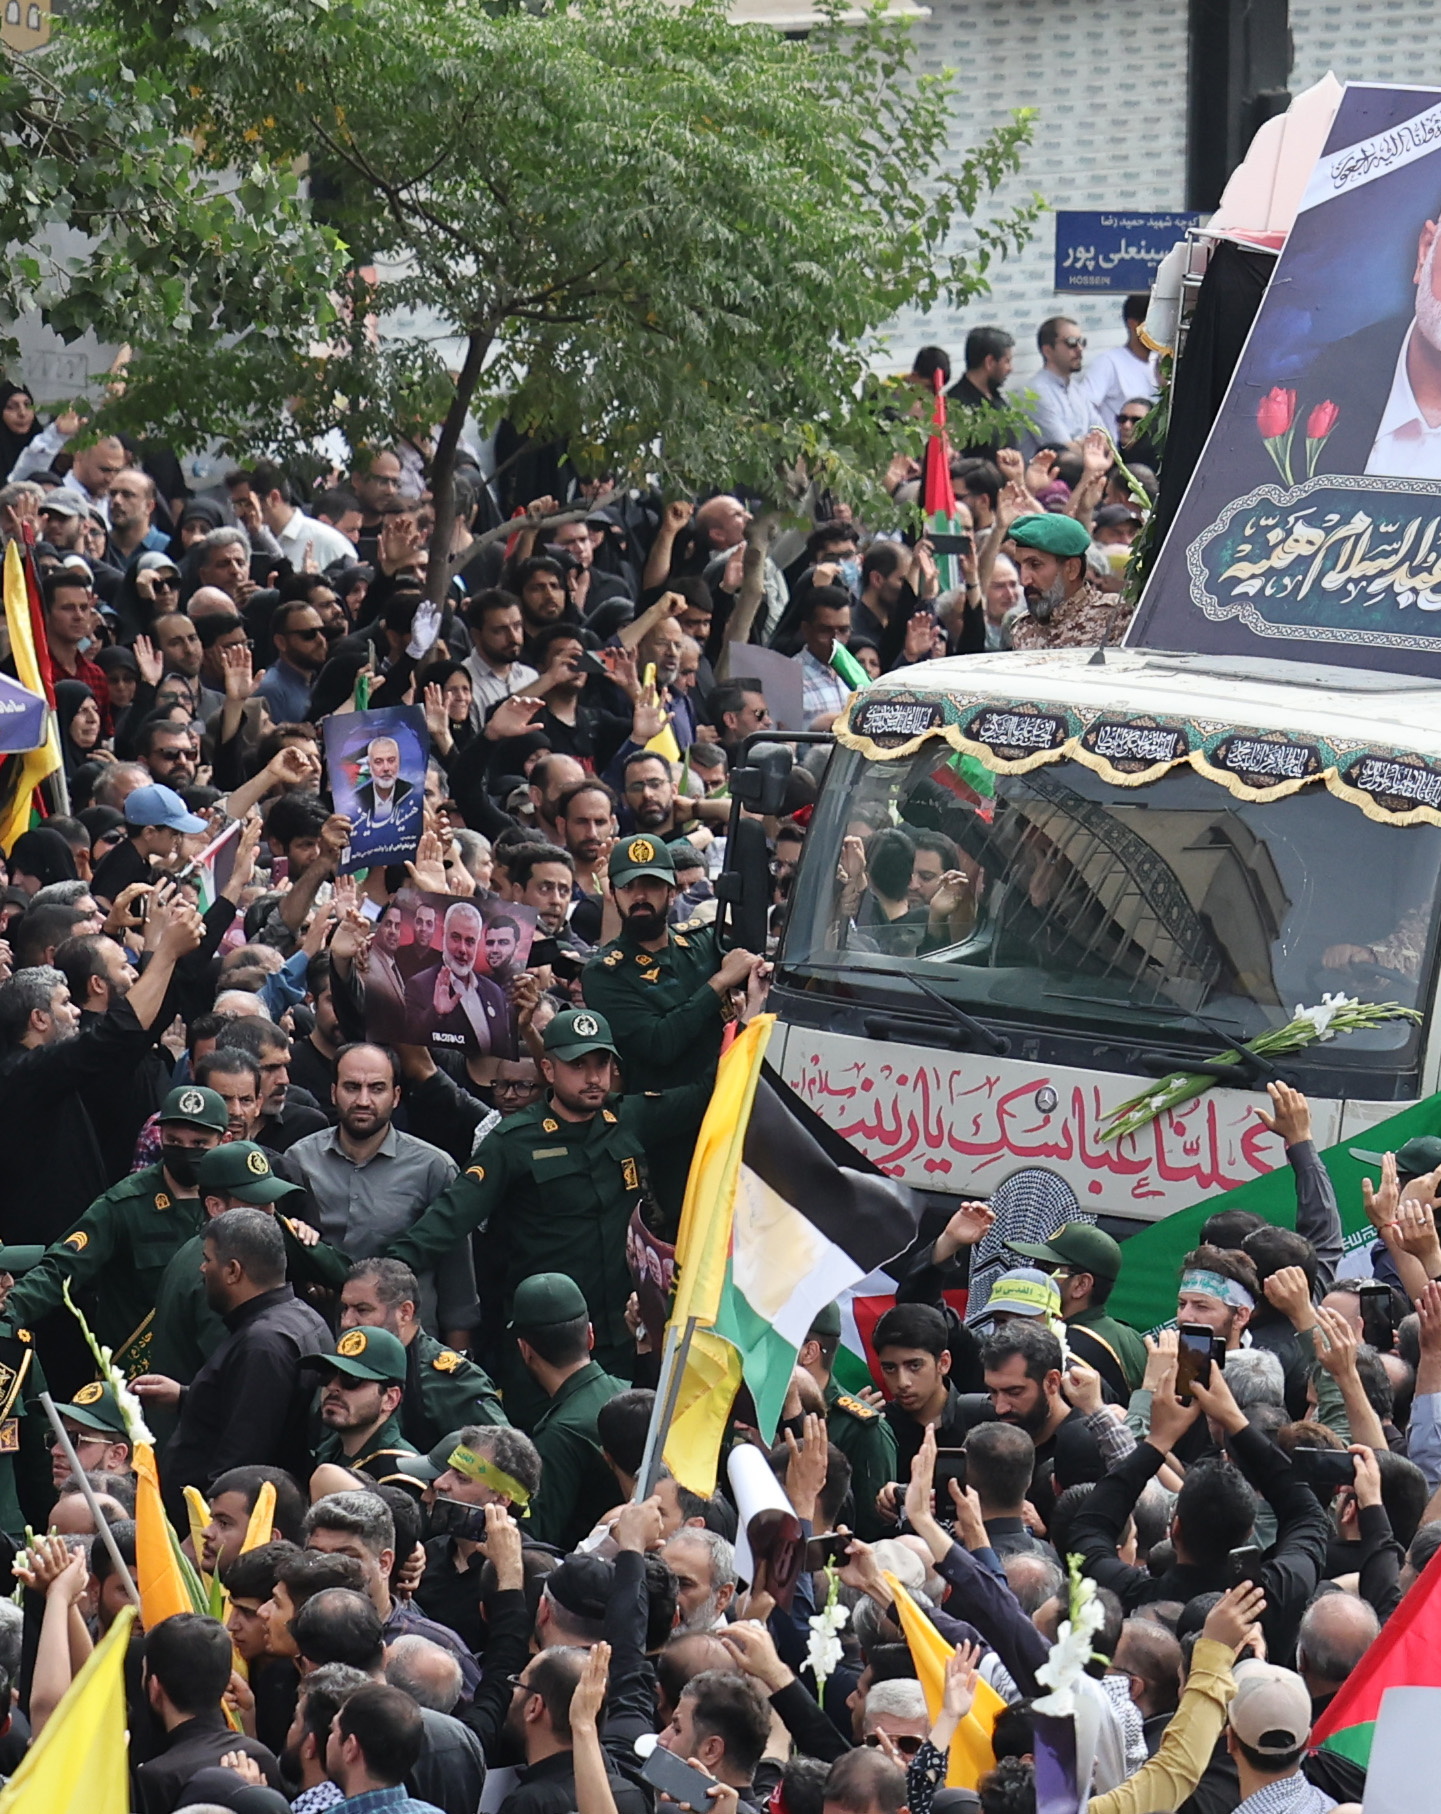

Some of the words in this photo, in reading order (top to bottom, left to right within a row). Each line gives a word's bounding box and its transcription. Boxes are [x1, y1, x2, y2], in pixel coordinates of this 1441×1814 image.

[1147, 216, 1173, 229] شهید
[1174, 217, 1198, 231] کوچه
[1063, 244, 1095, 271] پور
[1099, 238, 1170, 269] سینعلی
[1069, 276, 1111, 285] HOSSEIN
